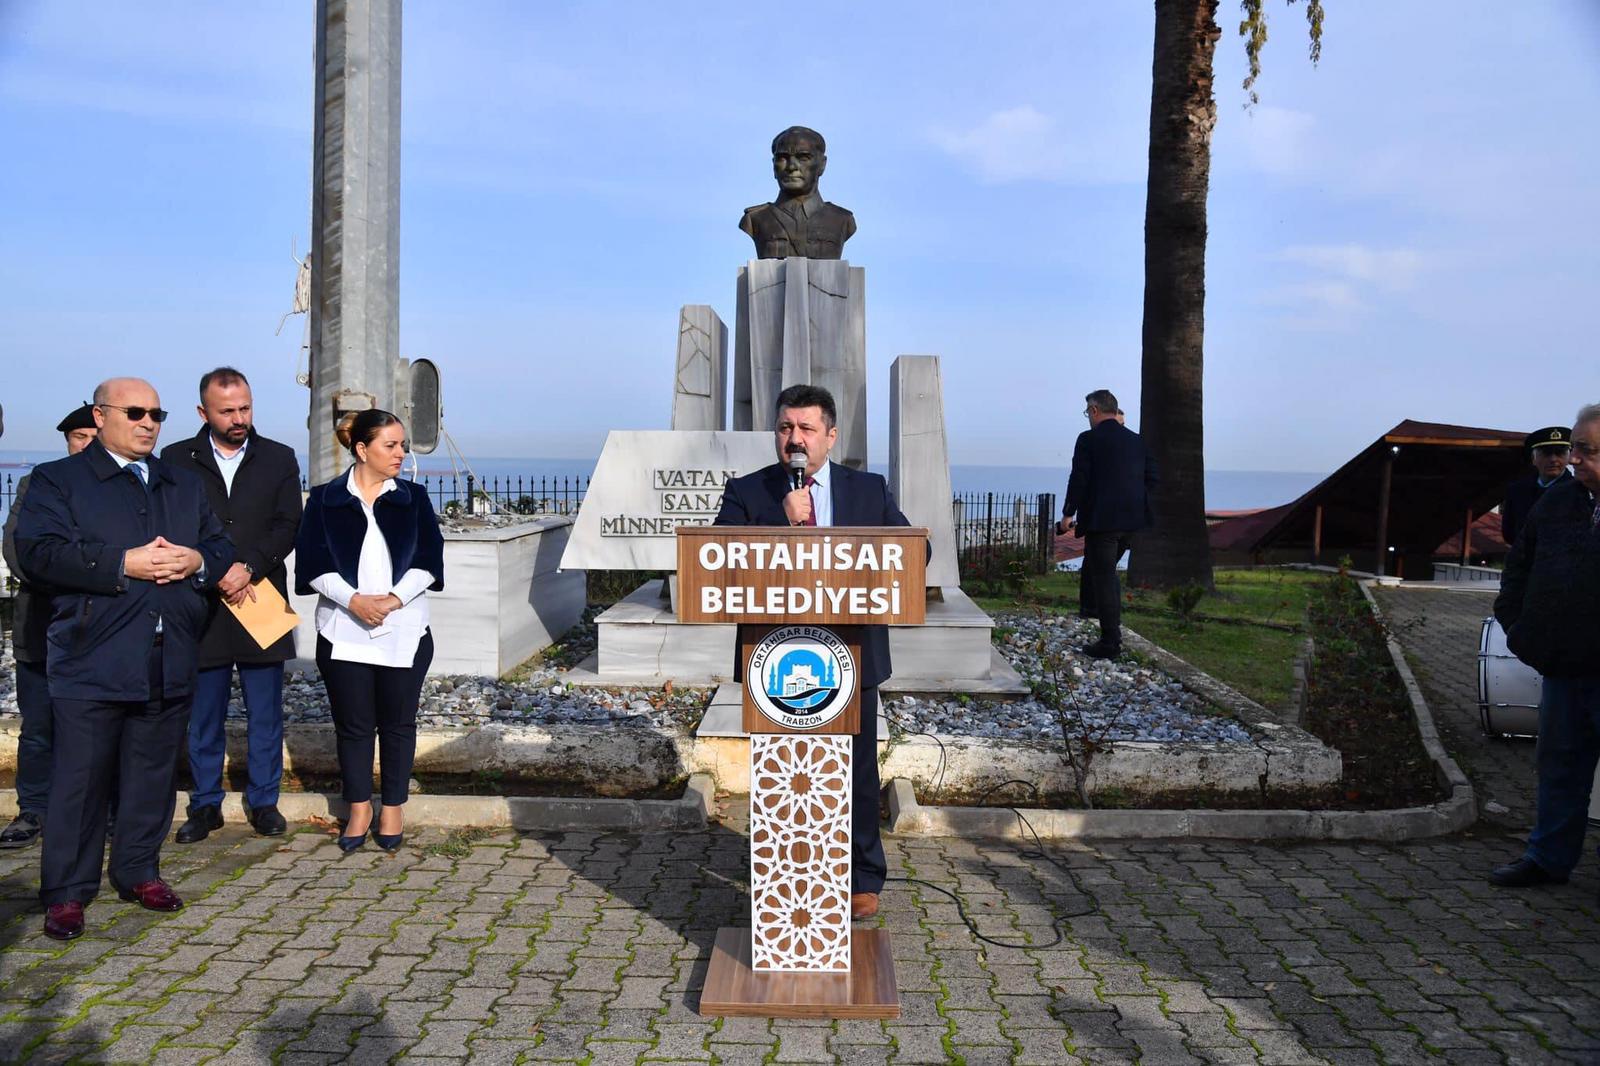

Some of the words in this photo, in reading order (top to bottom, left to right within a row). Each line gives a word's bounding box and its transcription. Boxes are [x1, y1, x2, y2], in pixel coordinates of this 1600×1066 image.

[699, 536, 903, 571] ORTAHİSAR
[701, 580, 900, 615] BELEDİYESİ
[753, 627, 801, 669] ORTAHİSAR
[804, 627, 852, 672] BELEDİYESİ
[781, 715, 823, 726] TRABZON
